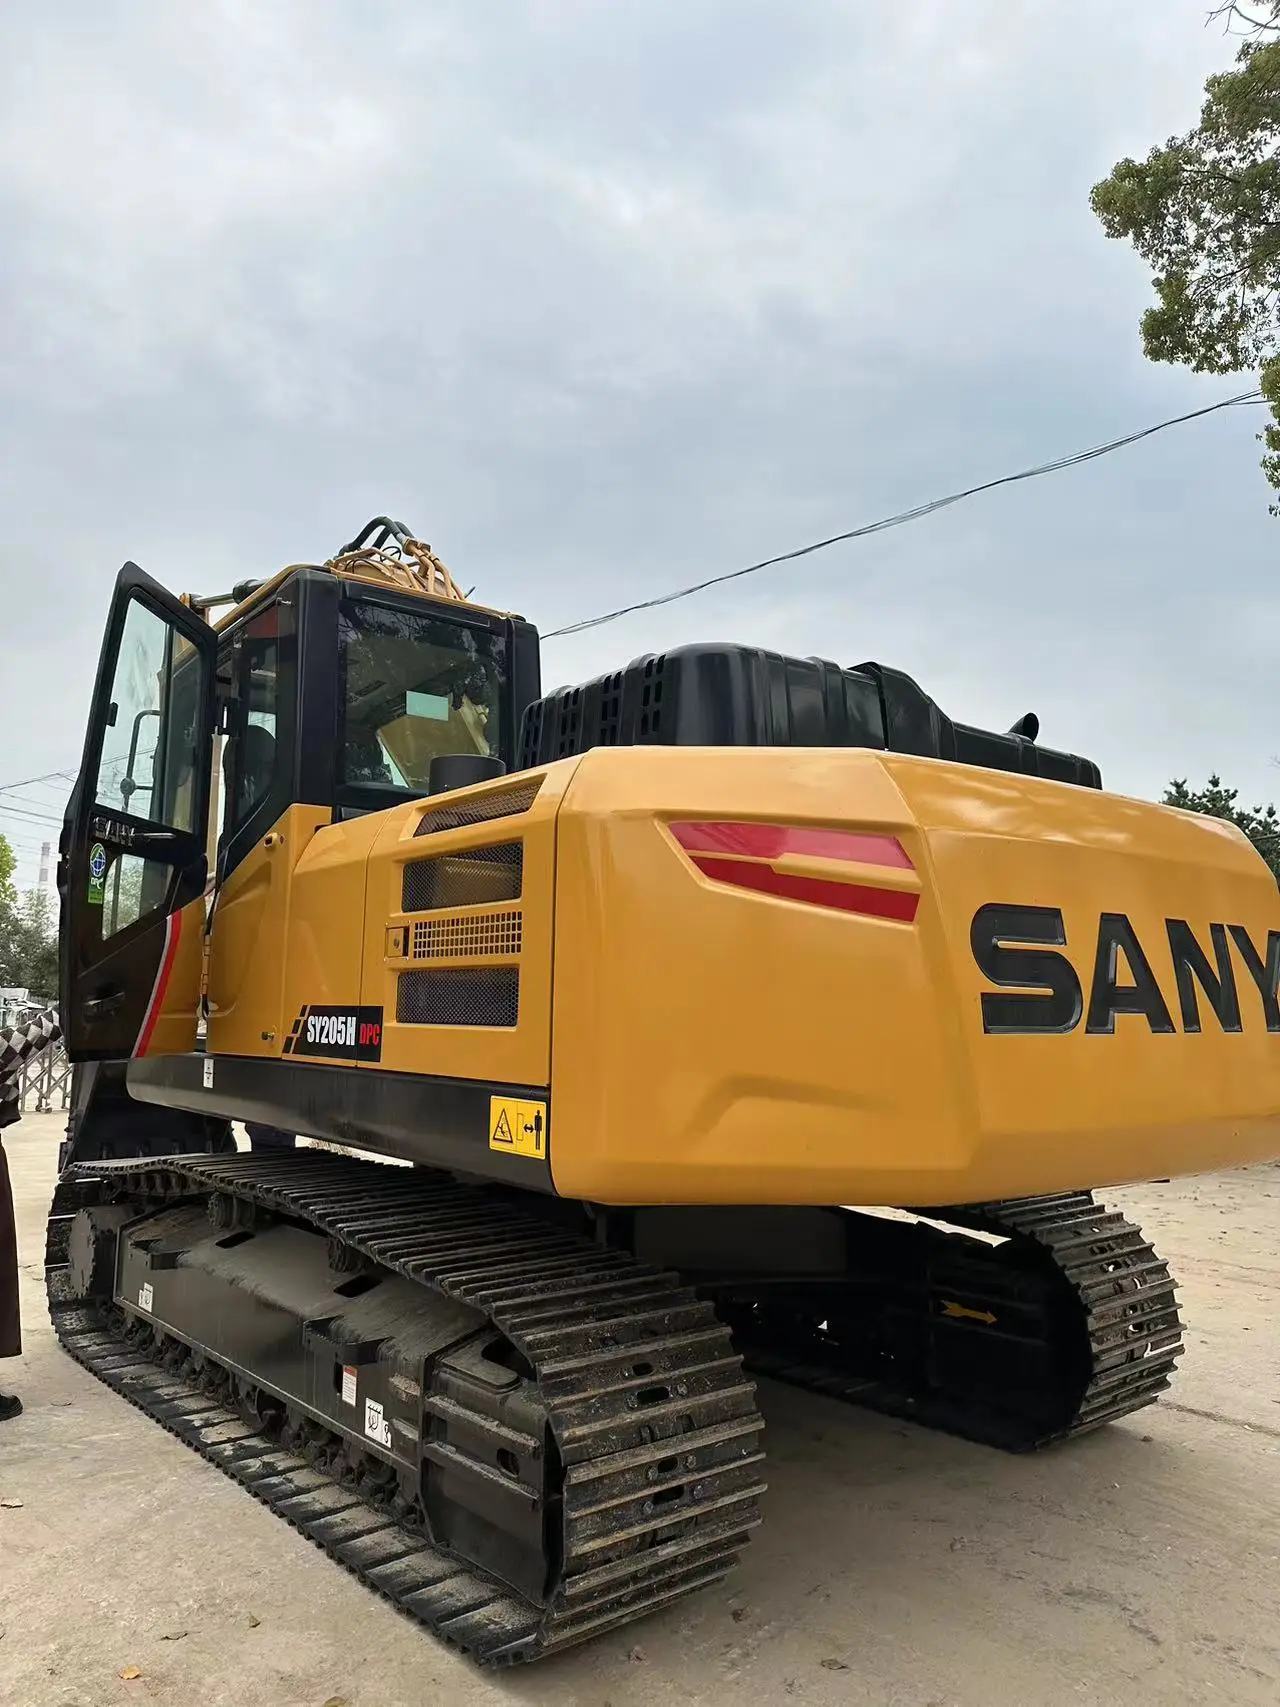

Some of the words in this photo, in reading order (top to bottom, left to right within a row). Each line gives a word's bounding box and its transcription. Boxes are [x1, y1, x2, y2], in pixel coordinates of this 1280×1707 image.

[970, 902, 1280, 1034] SANY
[307, 1015, 356, 1045] SY205H
[359, 1023, 380, 1046] DPC
